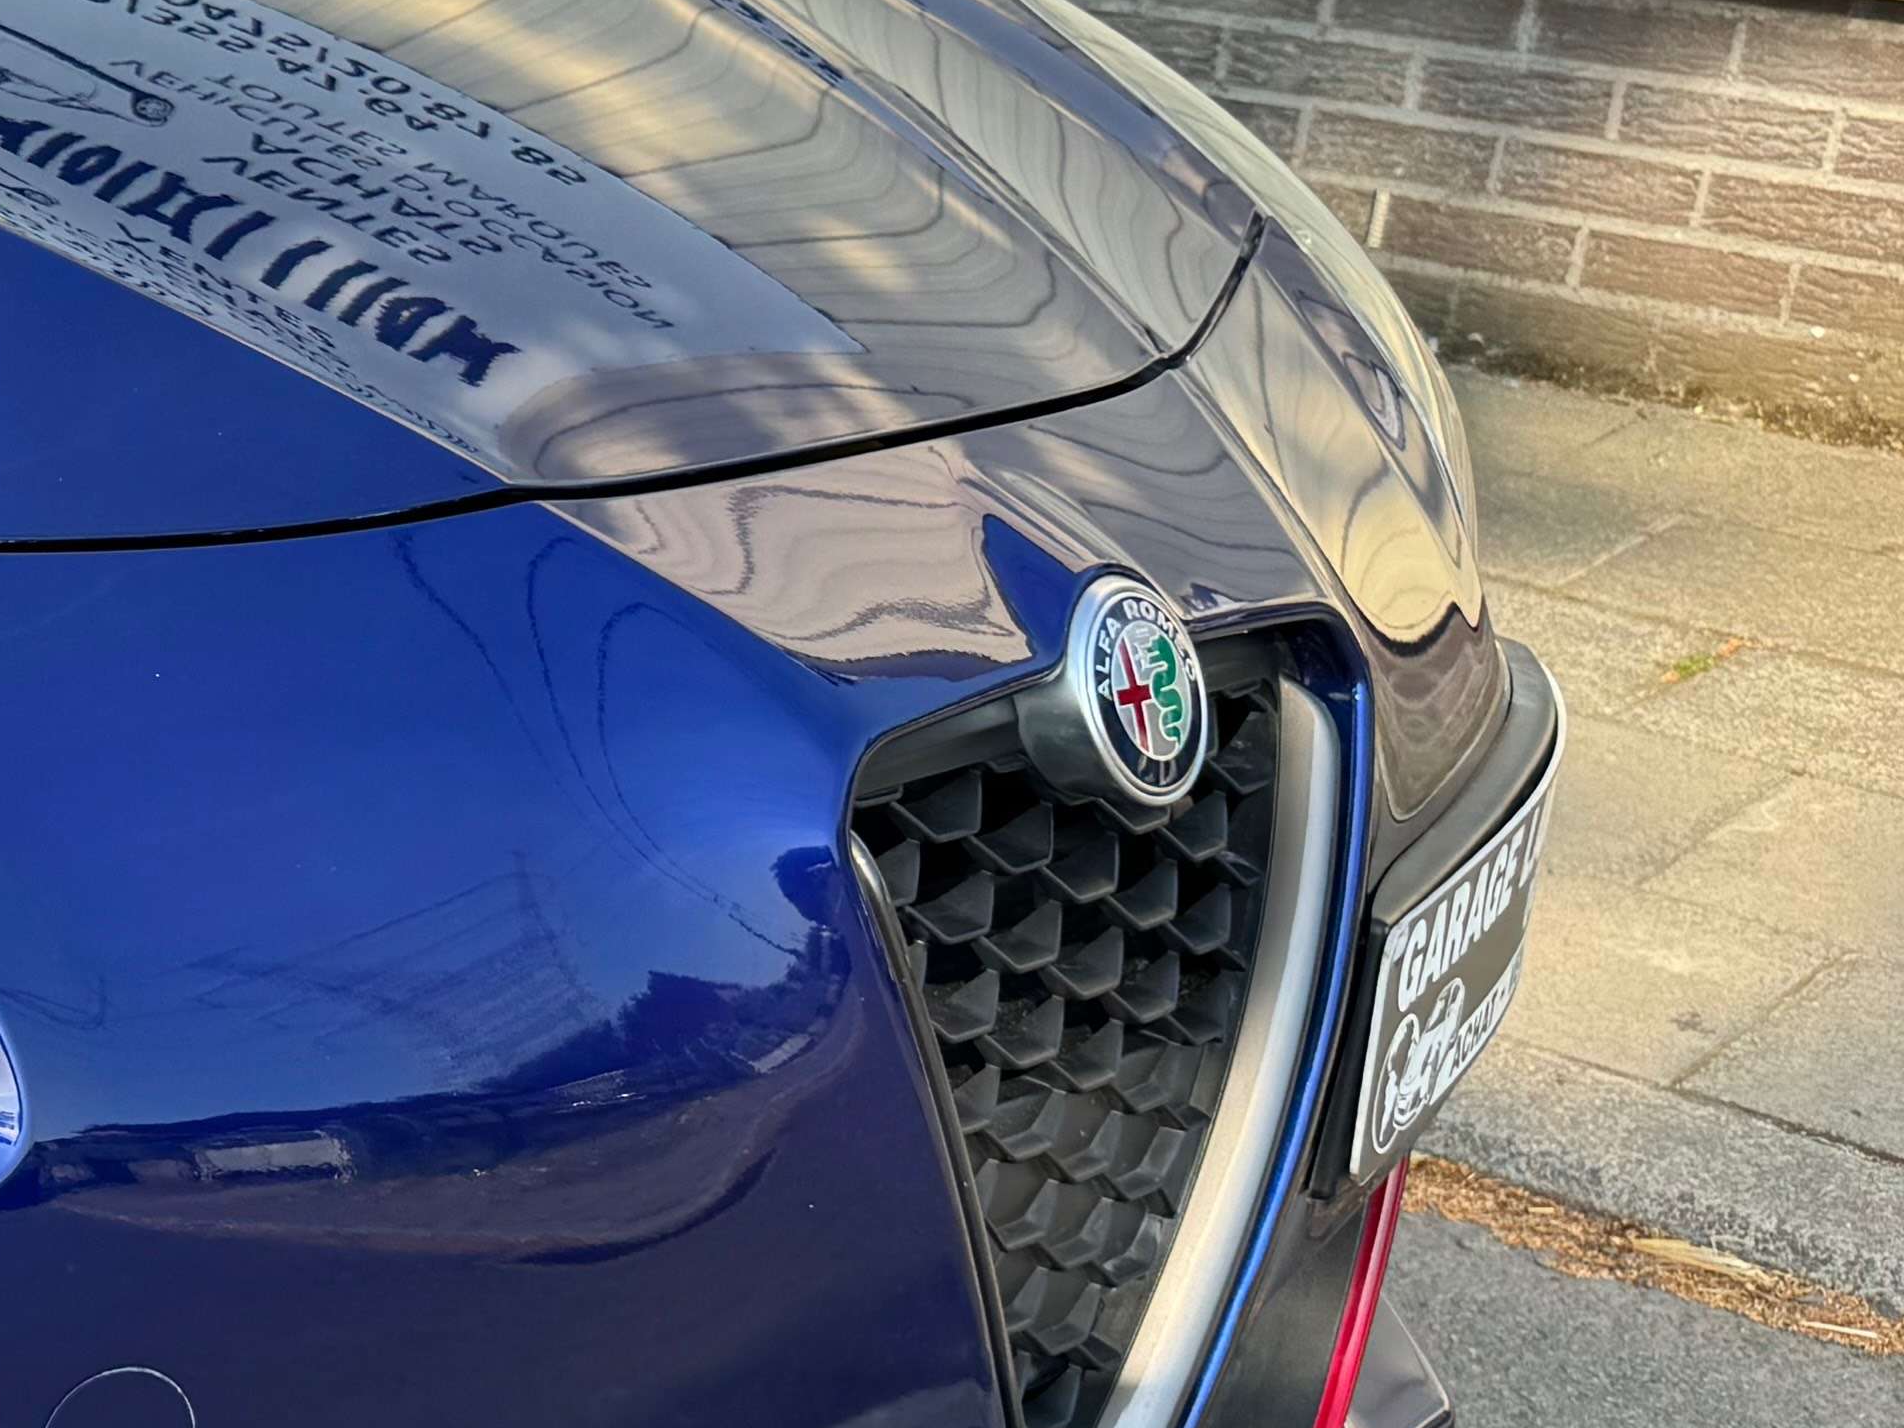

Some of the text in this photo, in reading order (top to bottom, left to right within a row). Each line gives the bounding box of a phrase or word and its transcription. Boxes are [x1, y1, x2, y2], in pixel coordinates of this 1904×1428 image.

[1096, 599, 1197, 701] ALFA ROMEO
[1397, 824, 1526, 1013] GARAGE
